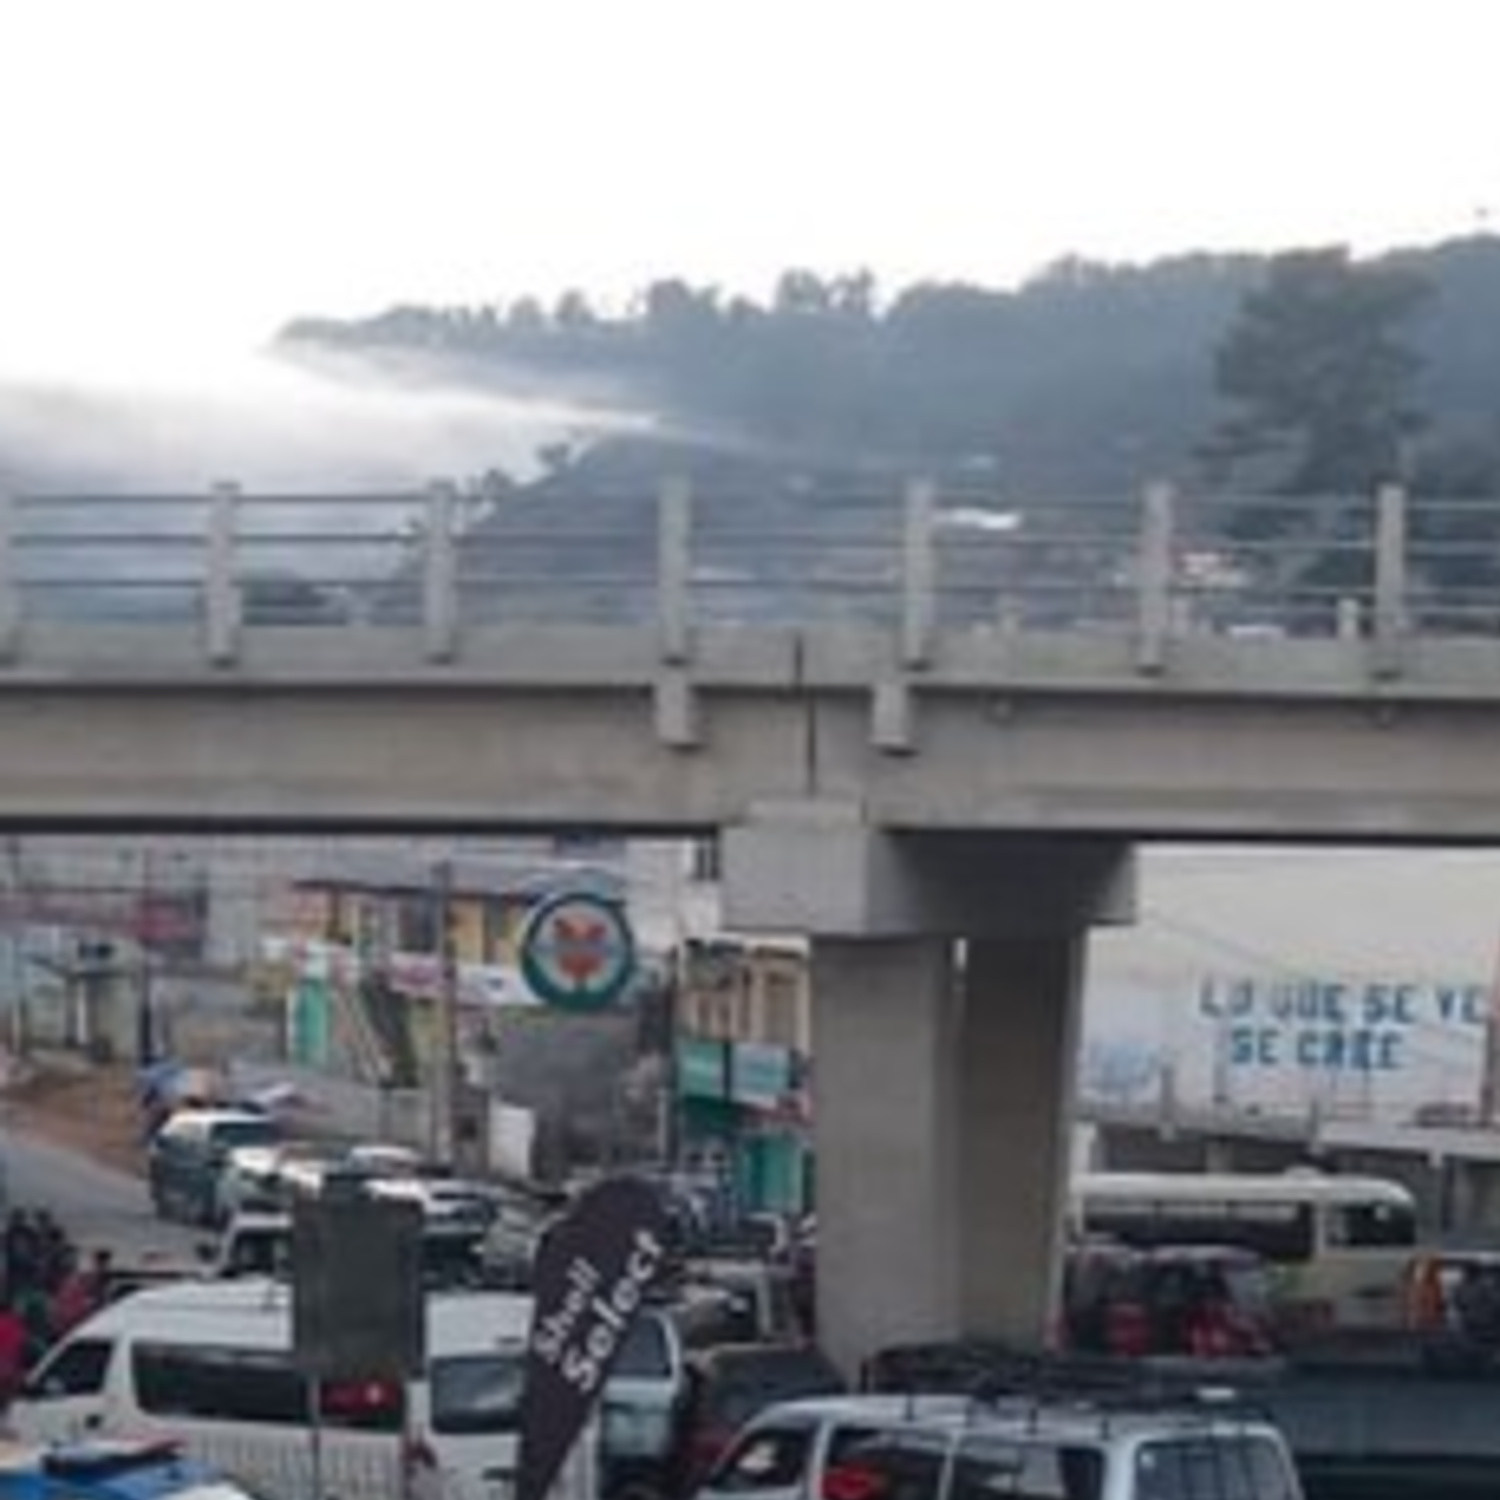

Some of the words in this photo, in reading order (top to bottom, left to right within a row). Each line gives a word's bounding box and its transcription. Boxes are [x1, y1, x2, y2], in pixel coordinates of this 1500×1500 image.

[1362, 983, 1413, 1024] SE
[1435, 985, 1487, 1024] VE
[1231, 1029, 1278, 1065] SE
[532, 1256, 600, 1363] Shell
[560, 1230, 662, 1391] Select
